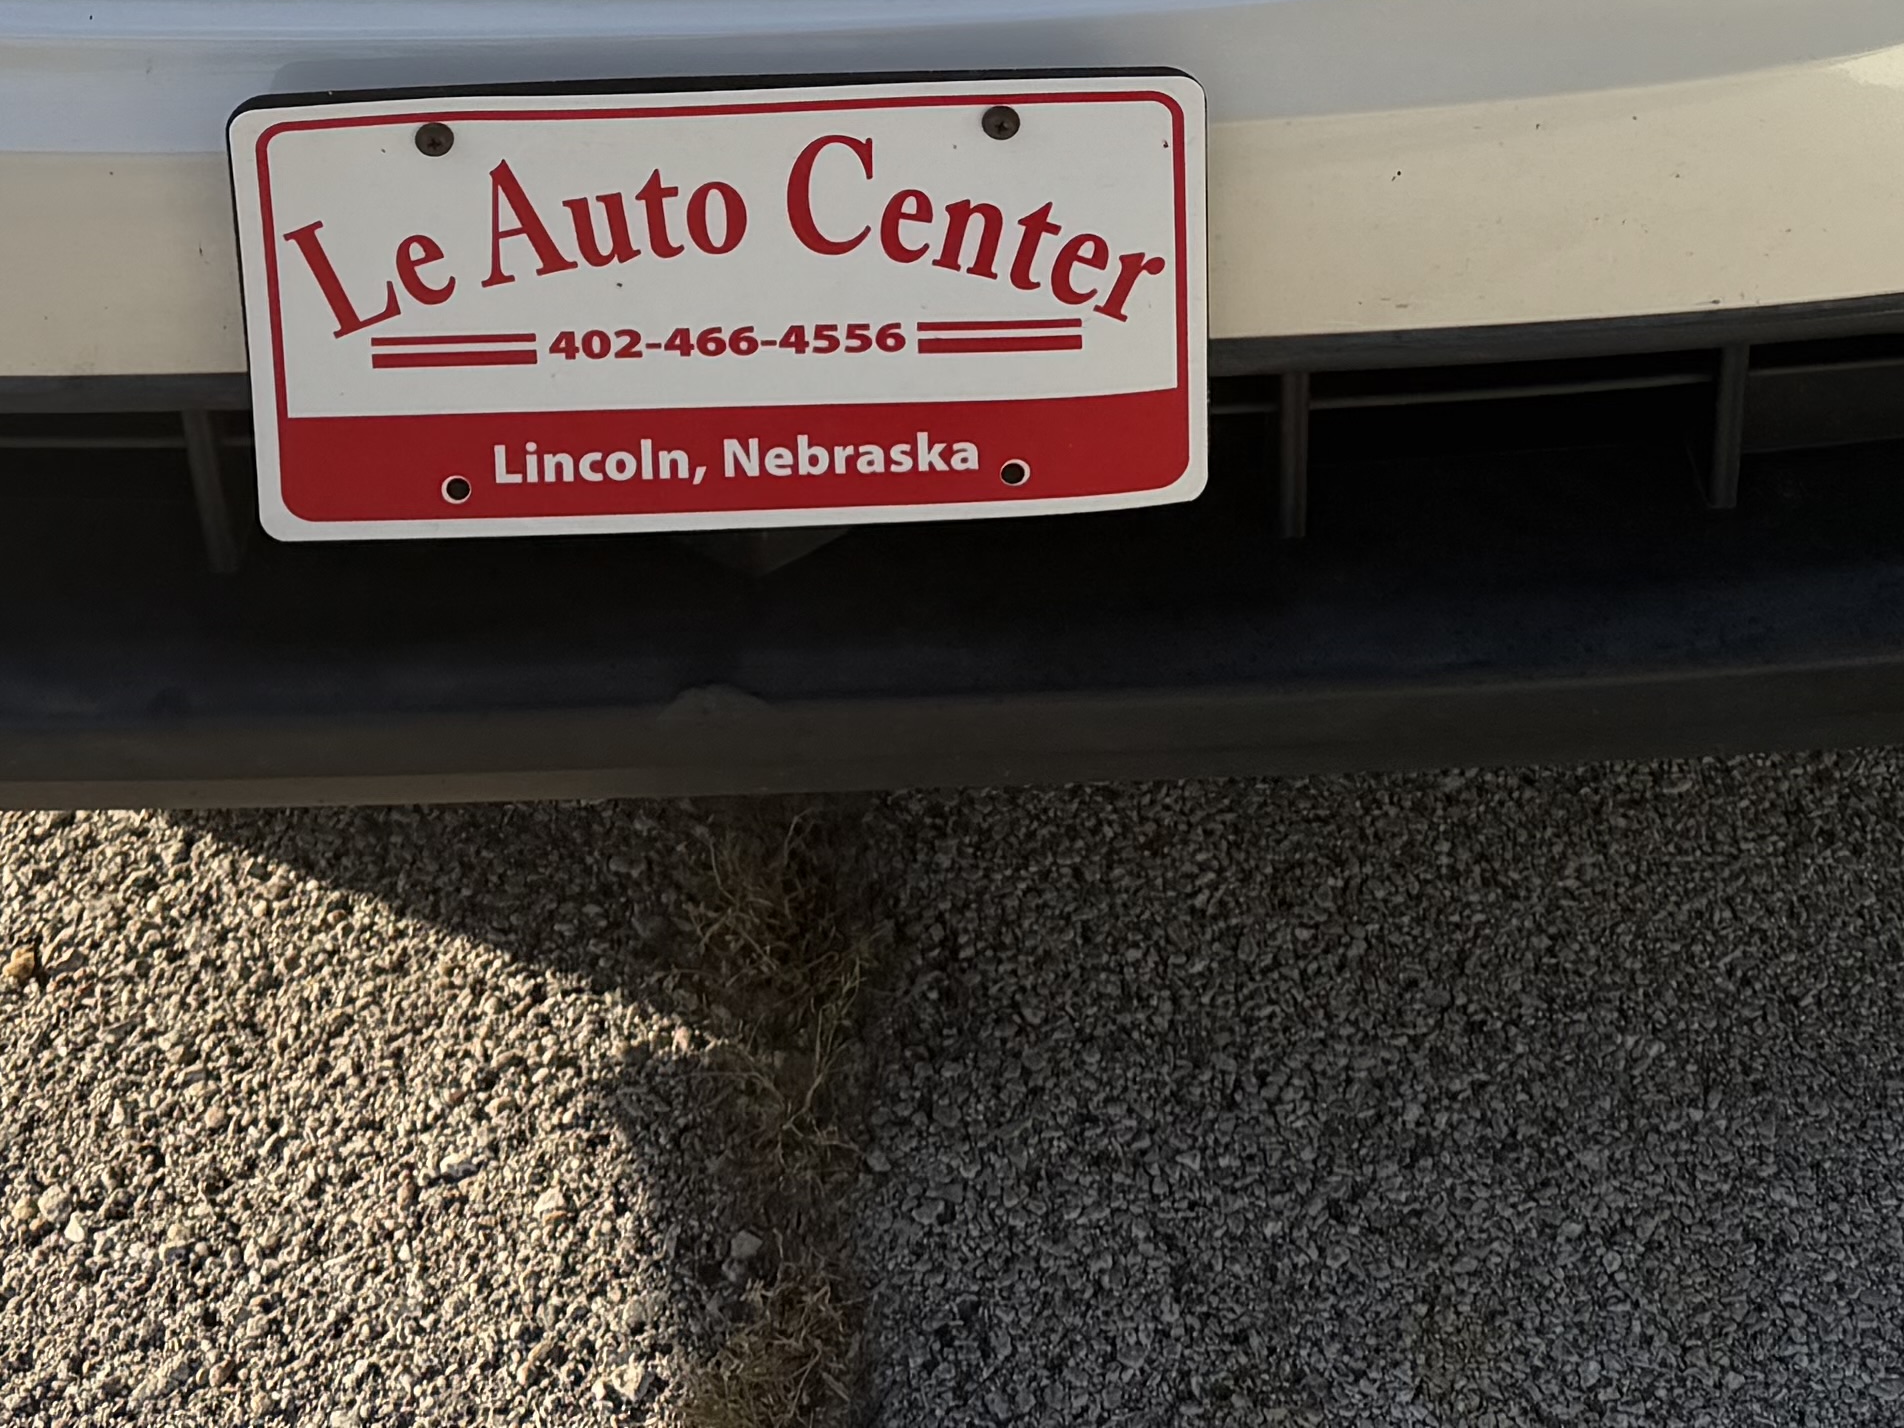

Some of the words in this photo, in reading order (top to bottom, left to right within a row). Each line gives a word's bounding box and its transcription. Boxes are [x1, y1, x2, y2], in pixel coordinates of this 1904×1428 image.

[284, 220, 456, 338] Le
[481, 158, 748, 288] Auto
[786, 134, 1166, 323] Center
[547, 322, 907, 361] 402-466-4556
[493, 437, 707, 485] Lincoln,
[722, 431, 980, 478] Nebraska
